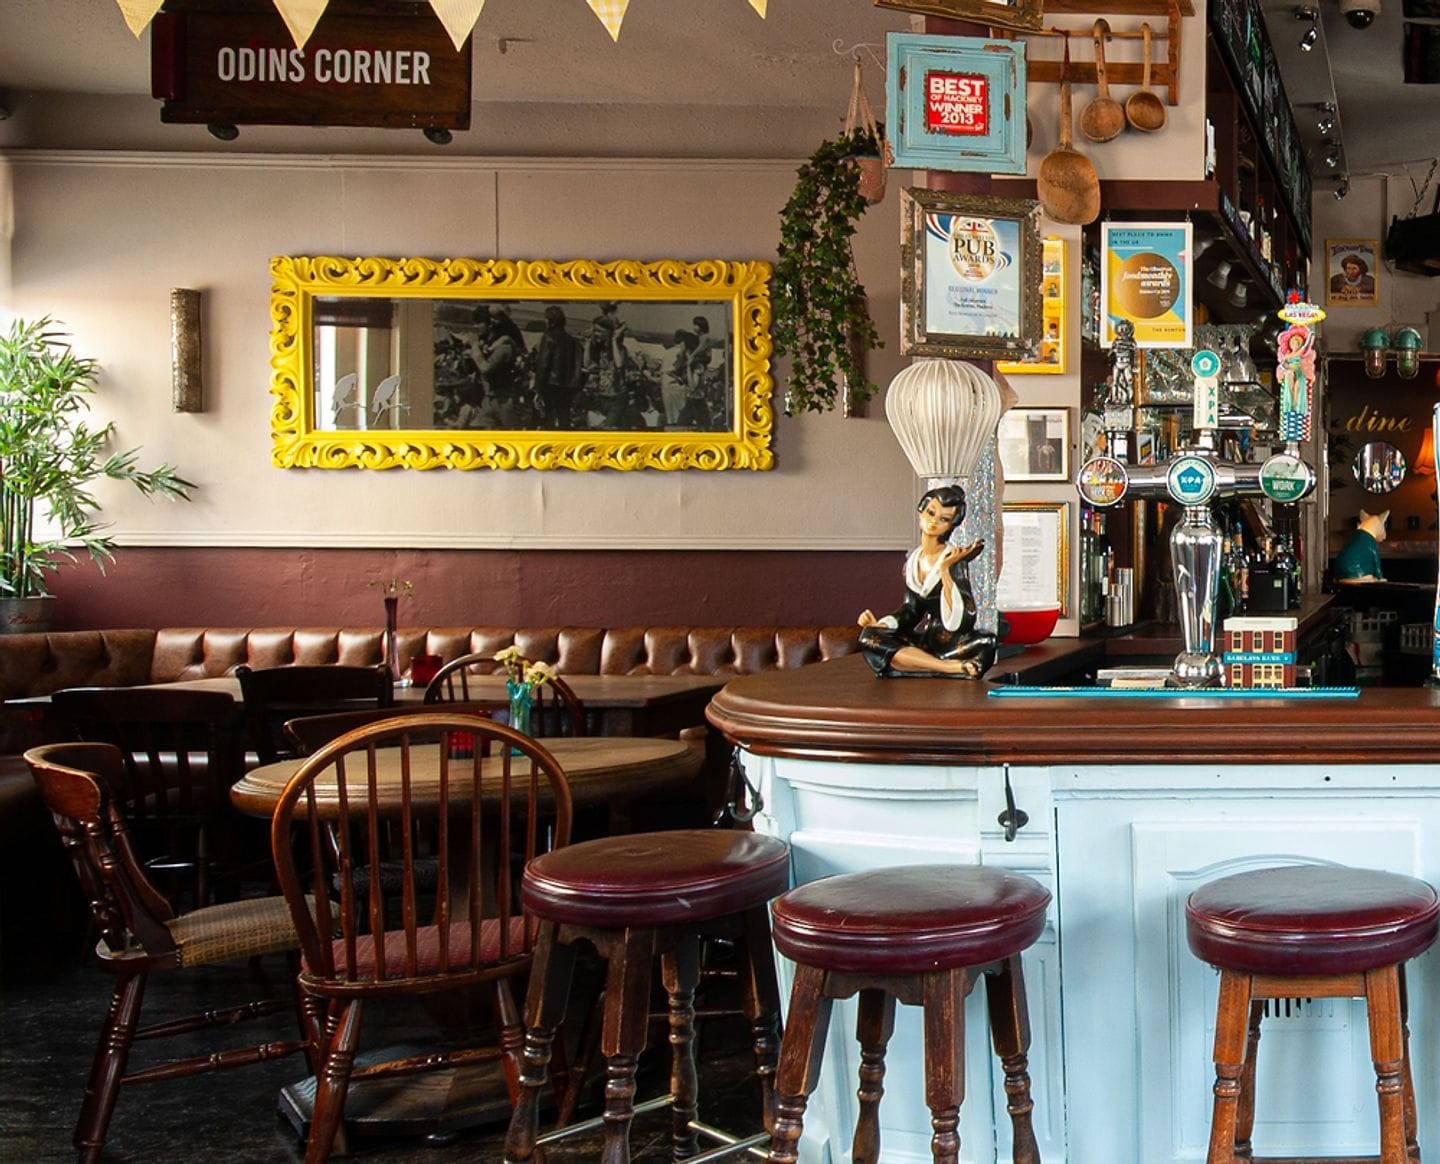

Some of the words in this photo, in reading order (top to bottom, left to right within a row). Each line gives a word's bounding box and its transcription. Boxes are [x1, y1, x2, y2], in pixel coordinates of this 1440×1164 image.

[218, 47, 305, 82] ODINS
[314, 48, 431, 85] CORNER
[930, 77, 985, 97] BEST
[930, 101, 984, 115] WINNER
[940, 112, 974, 125] 2013
[954, 238, 995, 256] PUB
[952, 254, 995, 265] AWARDS
[1345, 404, 1414, 432] dine
[1180, 475, 1200, 484] XPA
